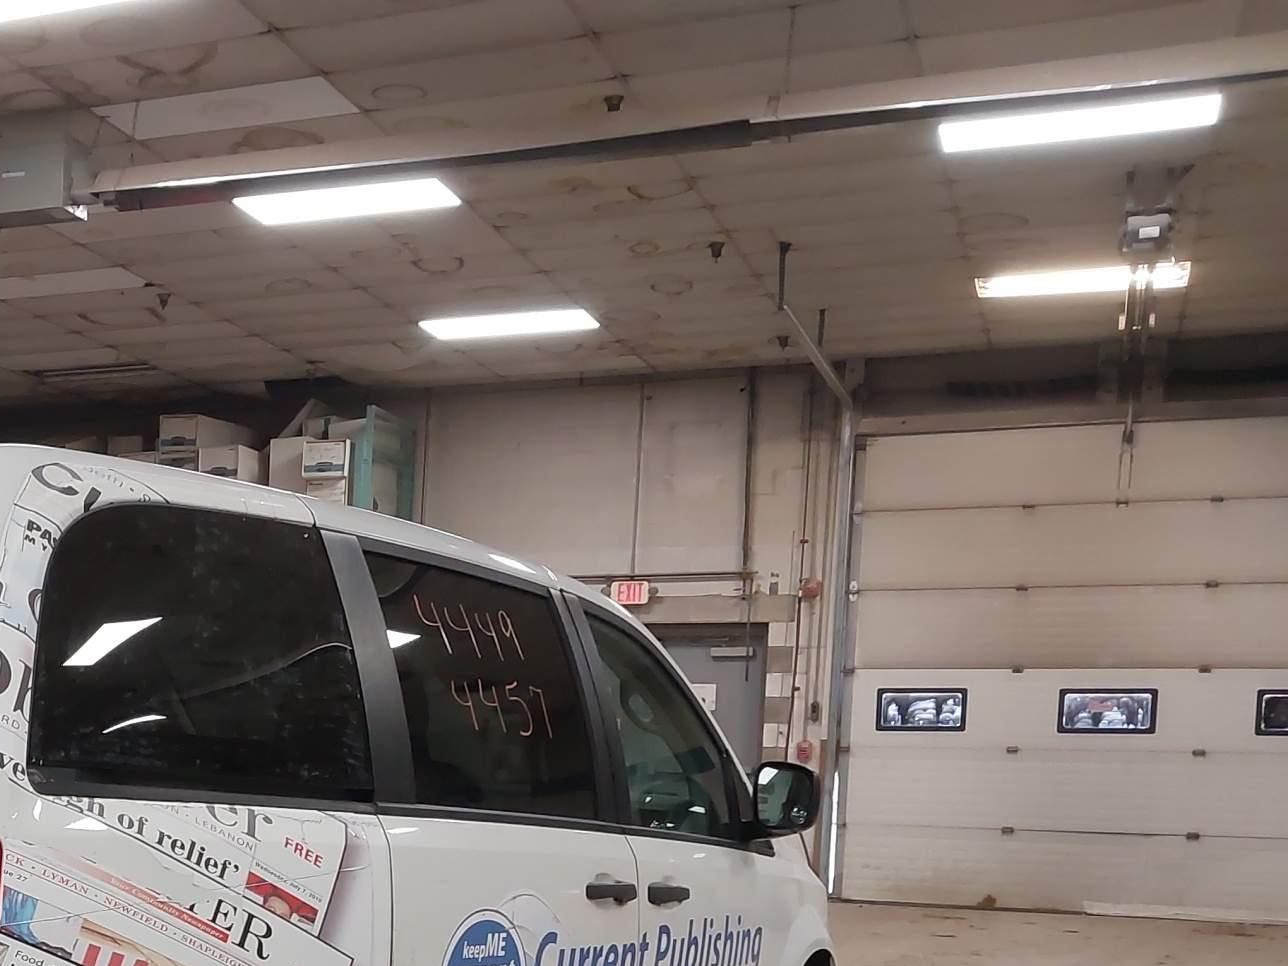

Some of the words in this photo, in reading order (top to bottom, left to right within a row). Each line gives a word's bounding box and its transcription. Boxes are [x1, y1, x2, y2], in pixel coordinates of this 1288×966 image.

[618, 582, 643, 602] EXIT
[414, 594, 525, 662] 4449
[451, 679, 553, 739] 4457
[117, 813, 148, 836] of
[195, 816, 255, 851] LEBANON
[284, 836, 324, 868] FREE
[42, 869, 89, 895] LYMAN
[104, 896, 168, 932] NEWFIELD
[463, 932, 508, 962] keepME
